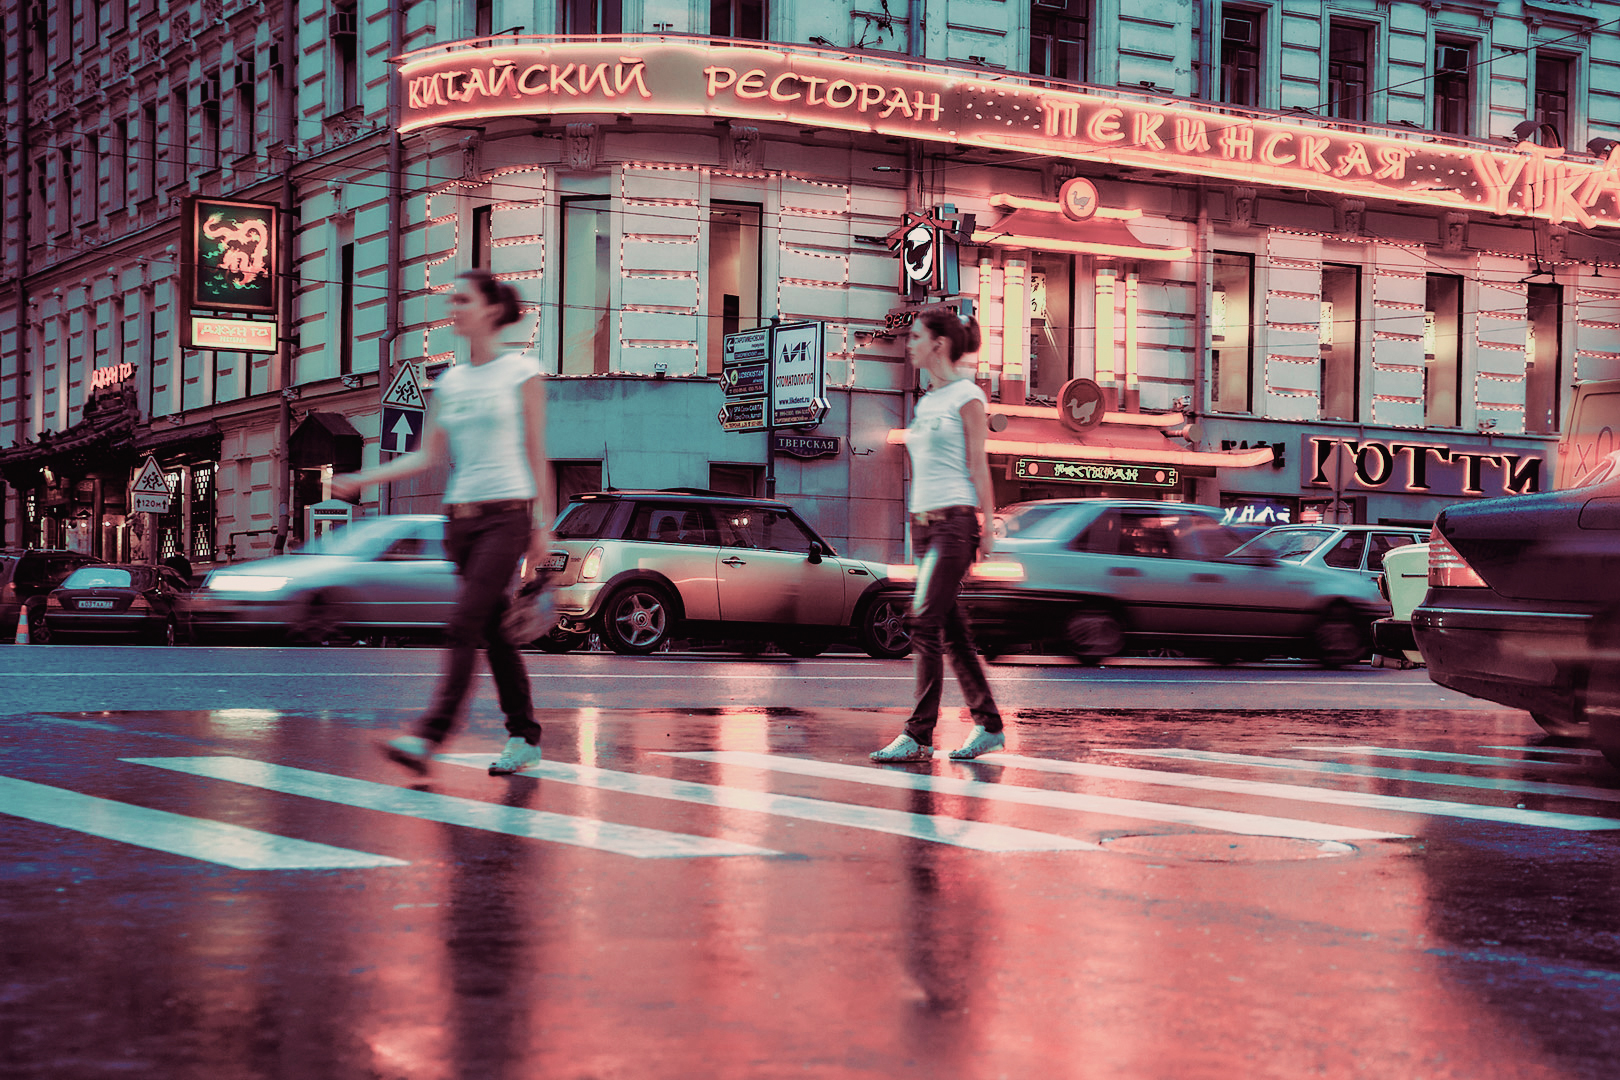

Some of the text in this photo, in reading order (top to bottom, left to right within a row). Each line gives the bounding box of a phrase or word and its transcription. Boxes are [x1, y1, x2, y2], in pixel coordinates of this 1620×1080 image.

[408, 56, 651, 109] КИТАЙСКИЙ
[704, 66, 942, 122] РЕСТОРАН
[1041, 99, 1411, 180] ПЕКИНСКАЯ
[776, 372, 814, 387] СТОМАТОЛОГИЯ
[779, 438, 834, 449] ТВЕРСКАЯ
[1054, 463, 1139, 481] РЕСТОРАН
